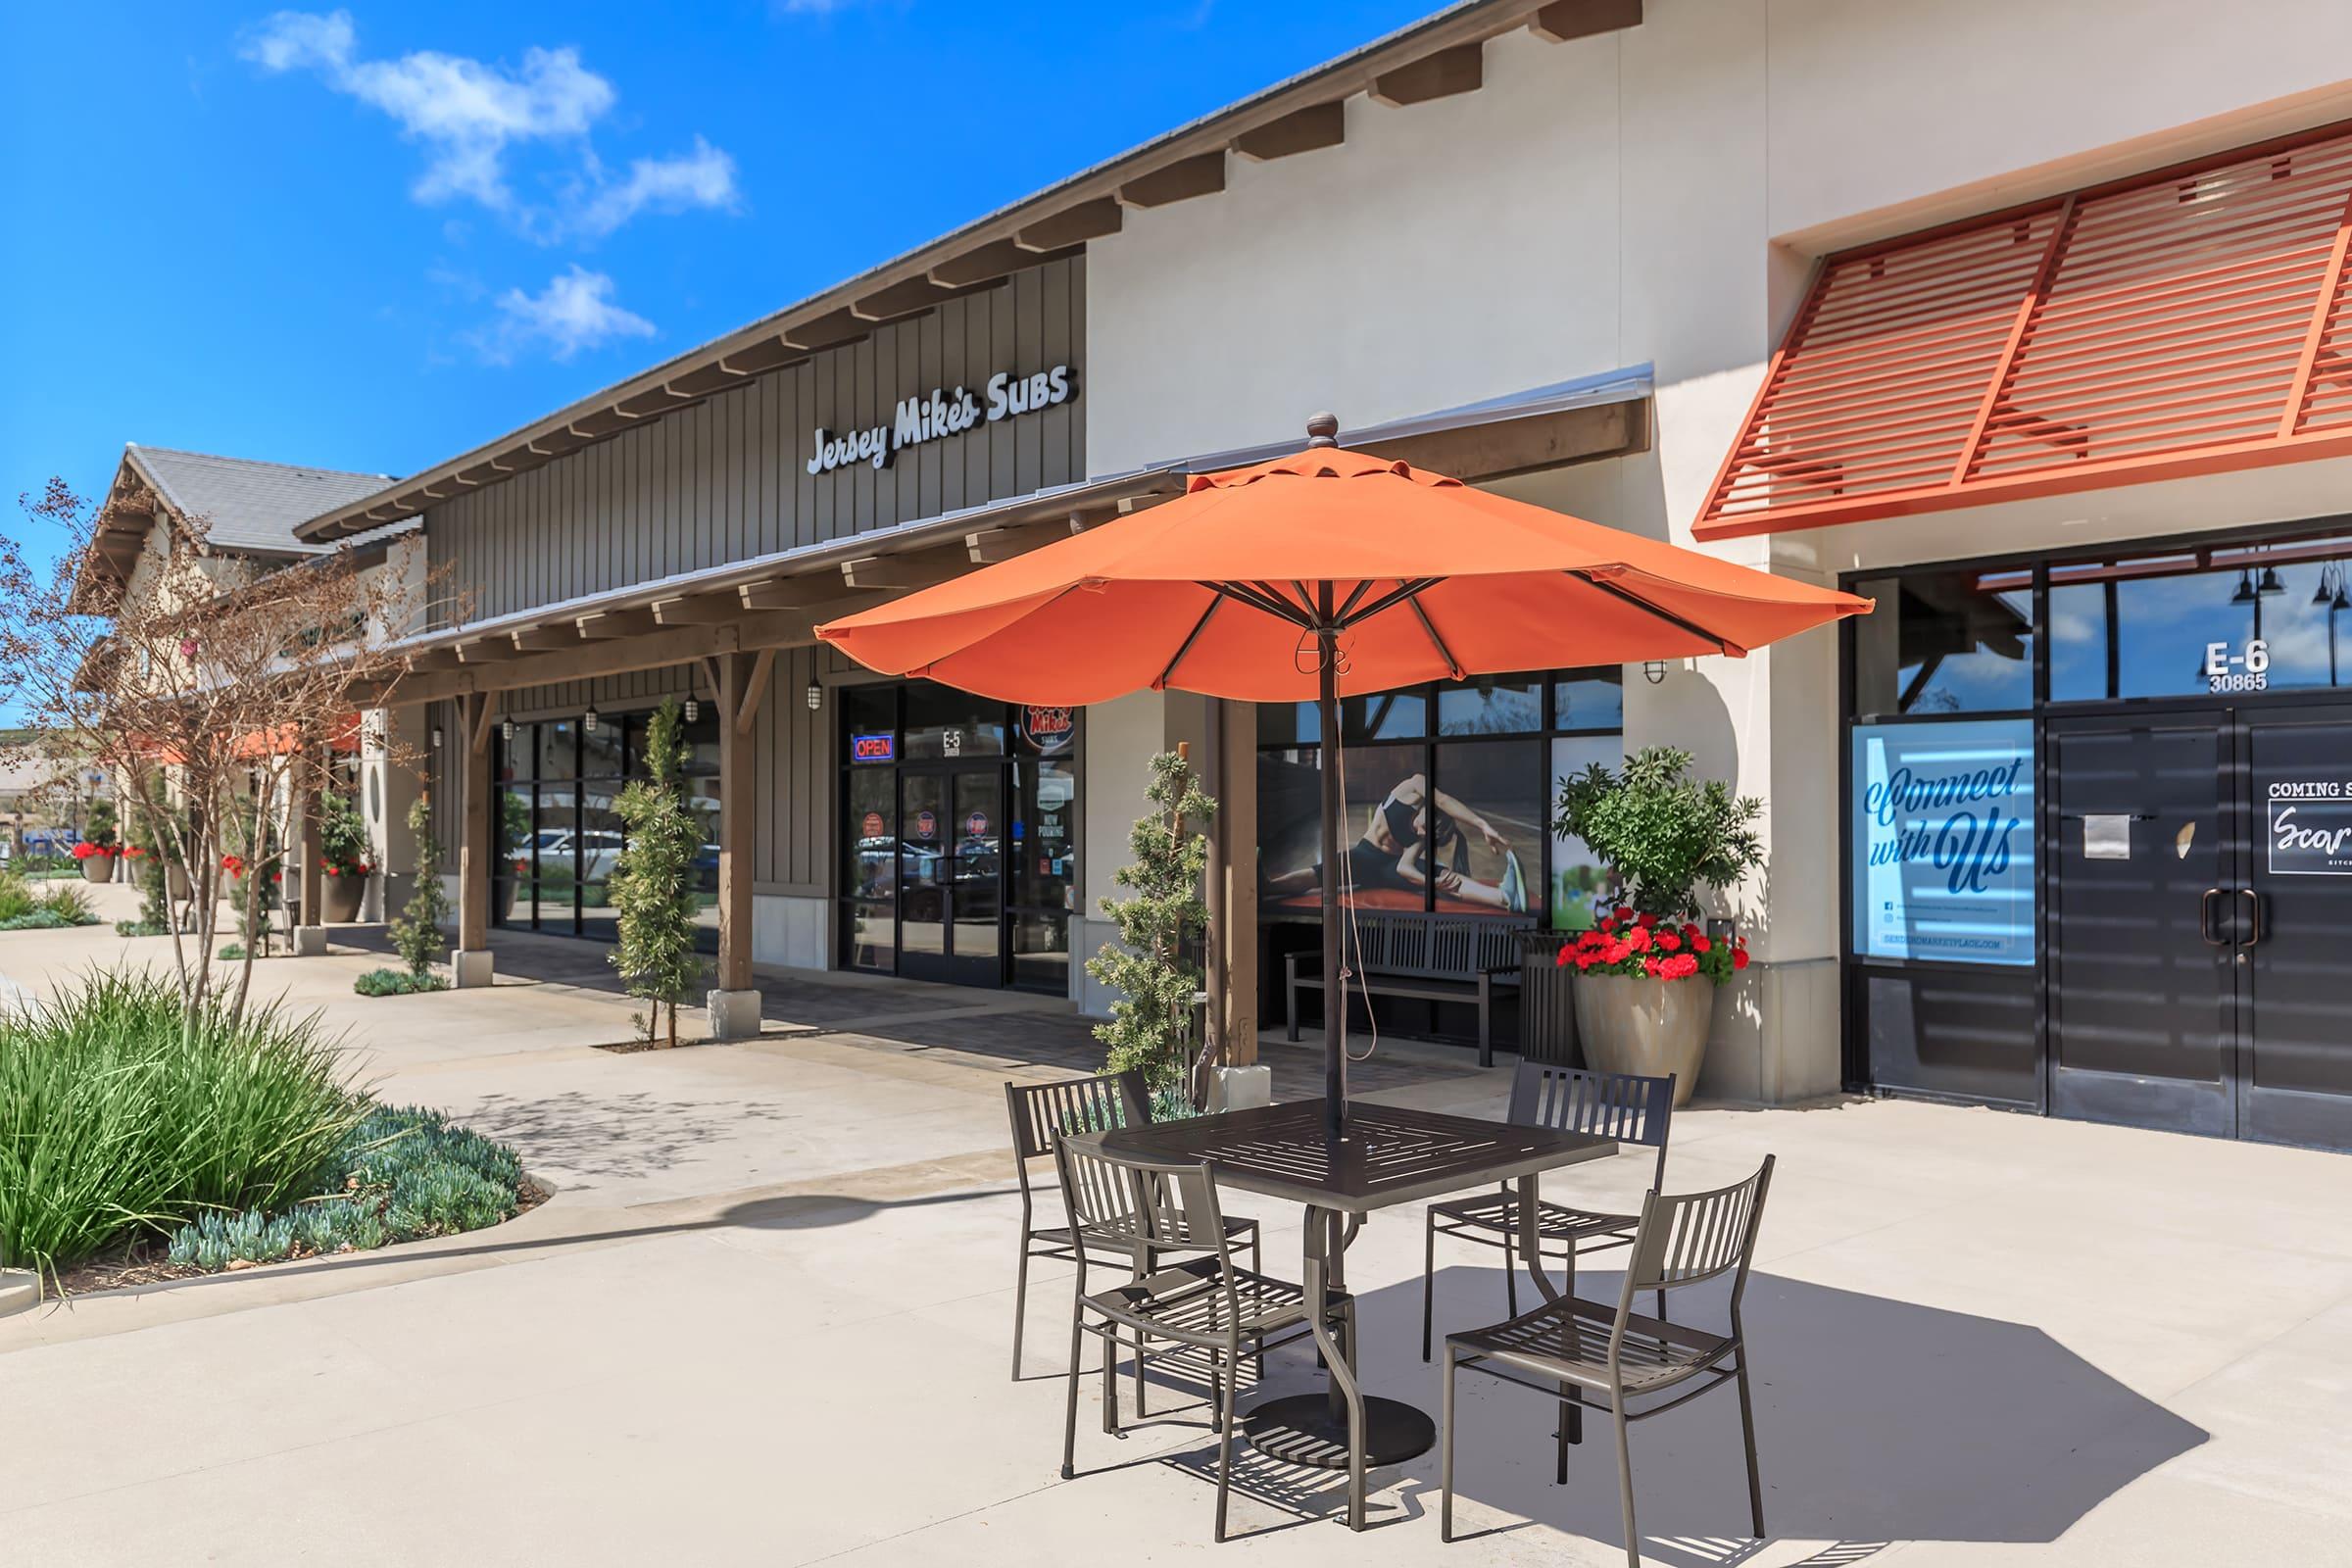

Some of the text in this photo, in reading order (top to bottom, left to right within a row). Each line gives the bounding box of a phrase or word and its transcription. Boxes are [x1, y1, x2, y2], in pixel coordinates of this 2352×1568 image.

[807, 427, 887, 475] Jersey
[893, 385, 980, 450] Mike's
[2207, 640, 2269, 675] E-6
[2210, 672, 2268, 693] 30865
[857, 739, 890, 757] OPEN
[943, 731, 960, 748] E-5
[1864, 758, 2024, 826] Connect
[2268, 782, 2340, 798] COMING
[1870, 807, 2020, 894] with Us
